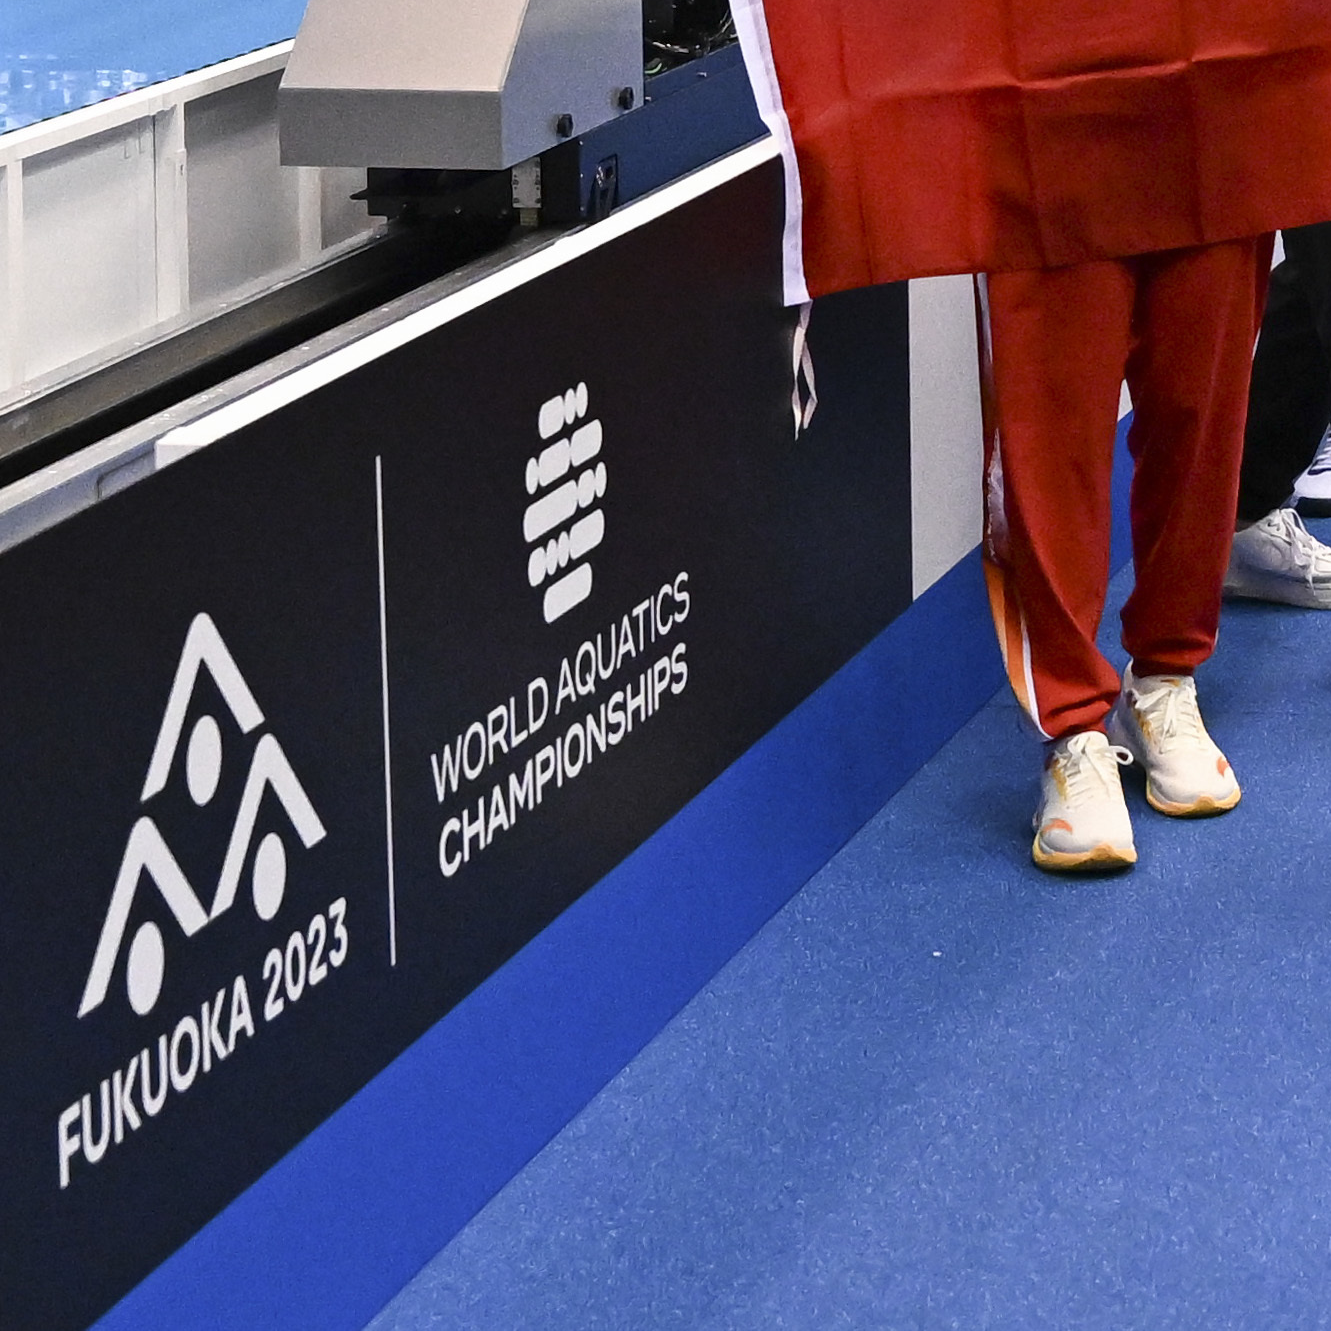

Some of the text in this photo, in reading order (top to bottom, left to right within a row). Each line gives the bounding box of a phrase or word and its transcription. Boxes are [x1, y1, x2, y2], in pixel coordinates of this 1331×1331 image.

[430, 570, 692, 805] WORLD AQUATICS
[438, 641, 690, 879] CHAMPIONSHIPS
[56, 895, 348, 1191] FUKUOKA 2023
